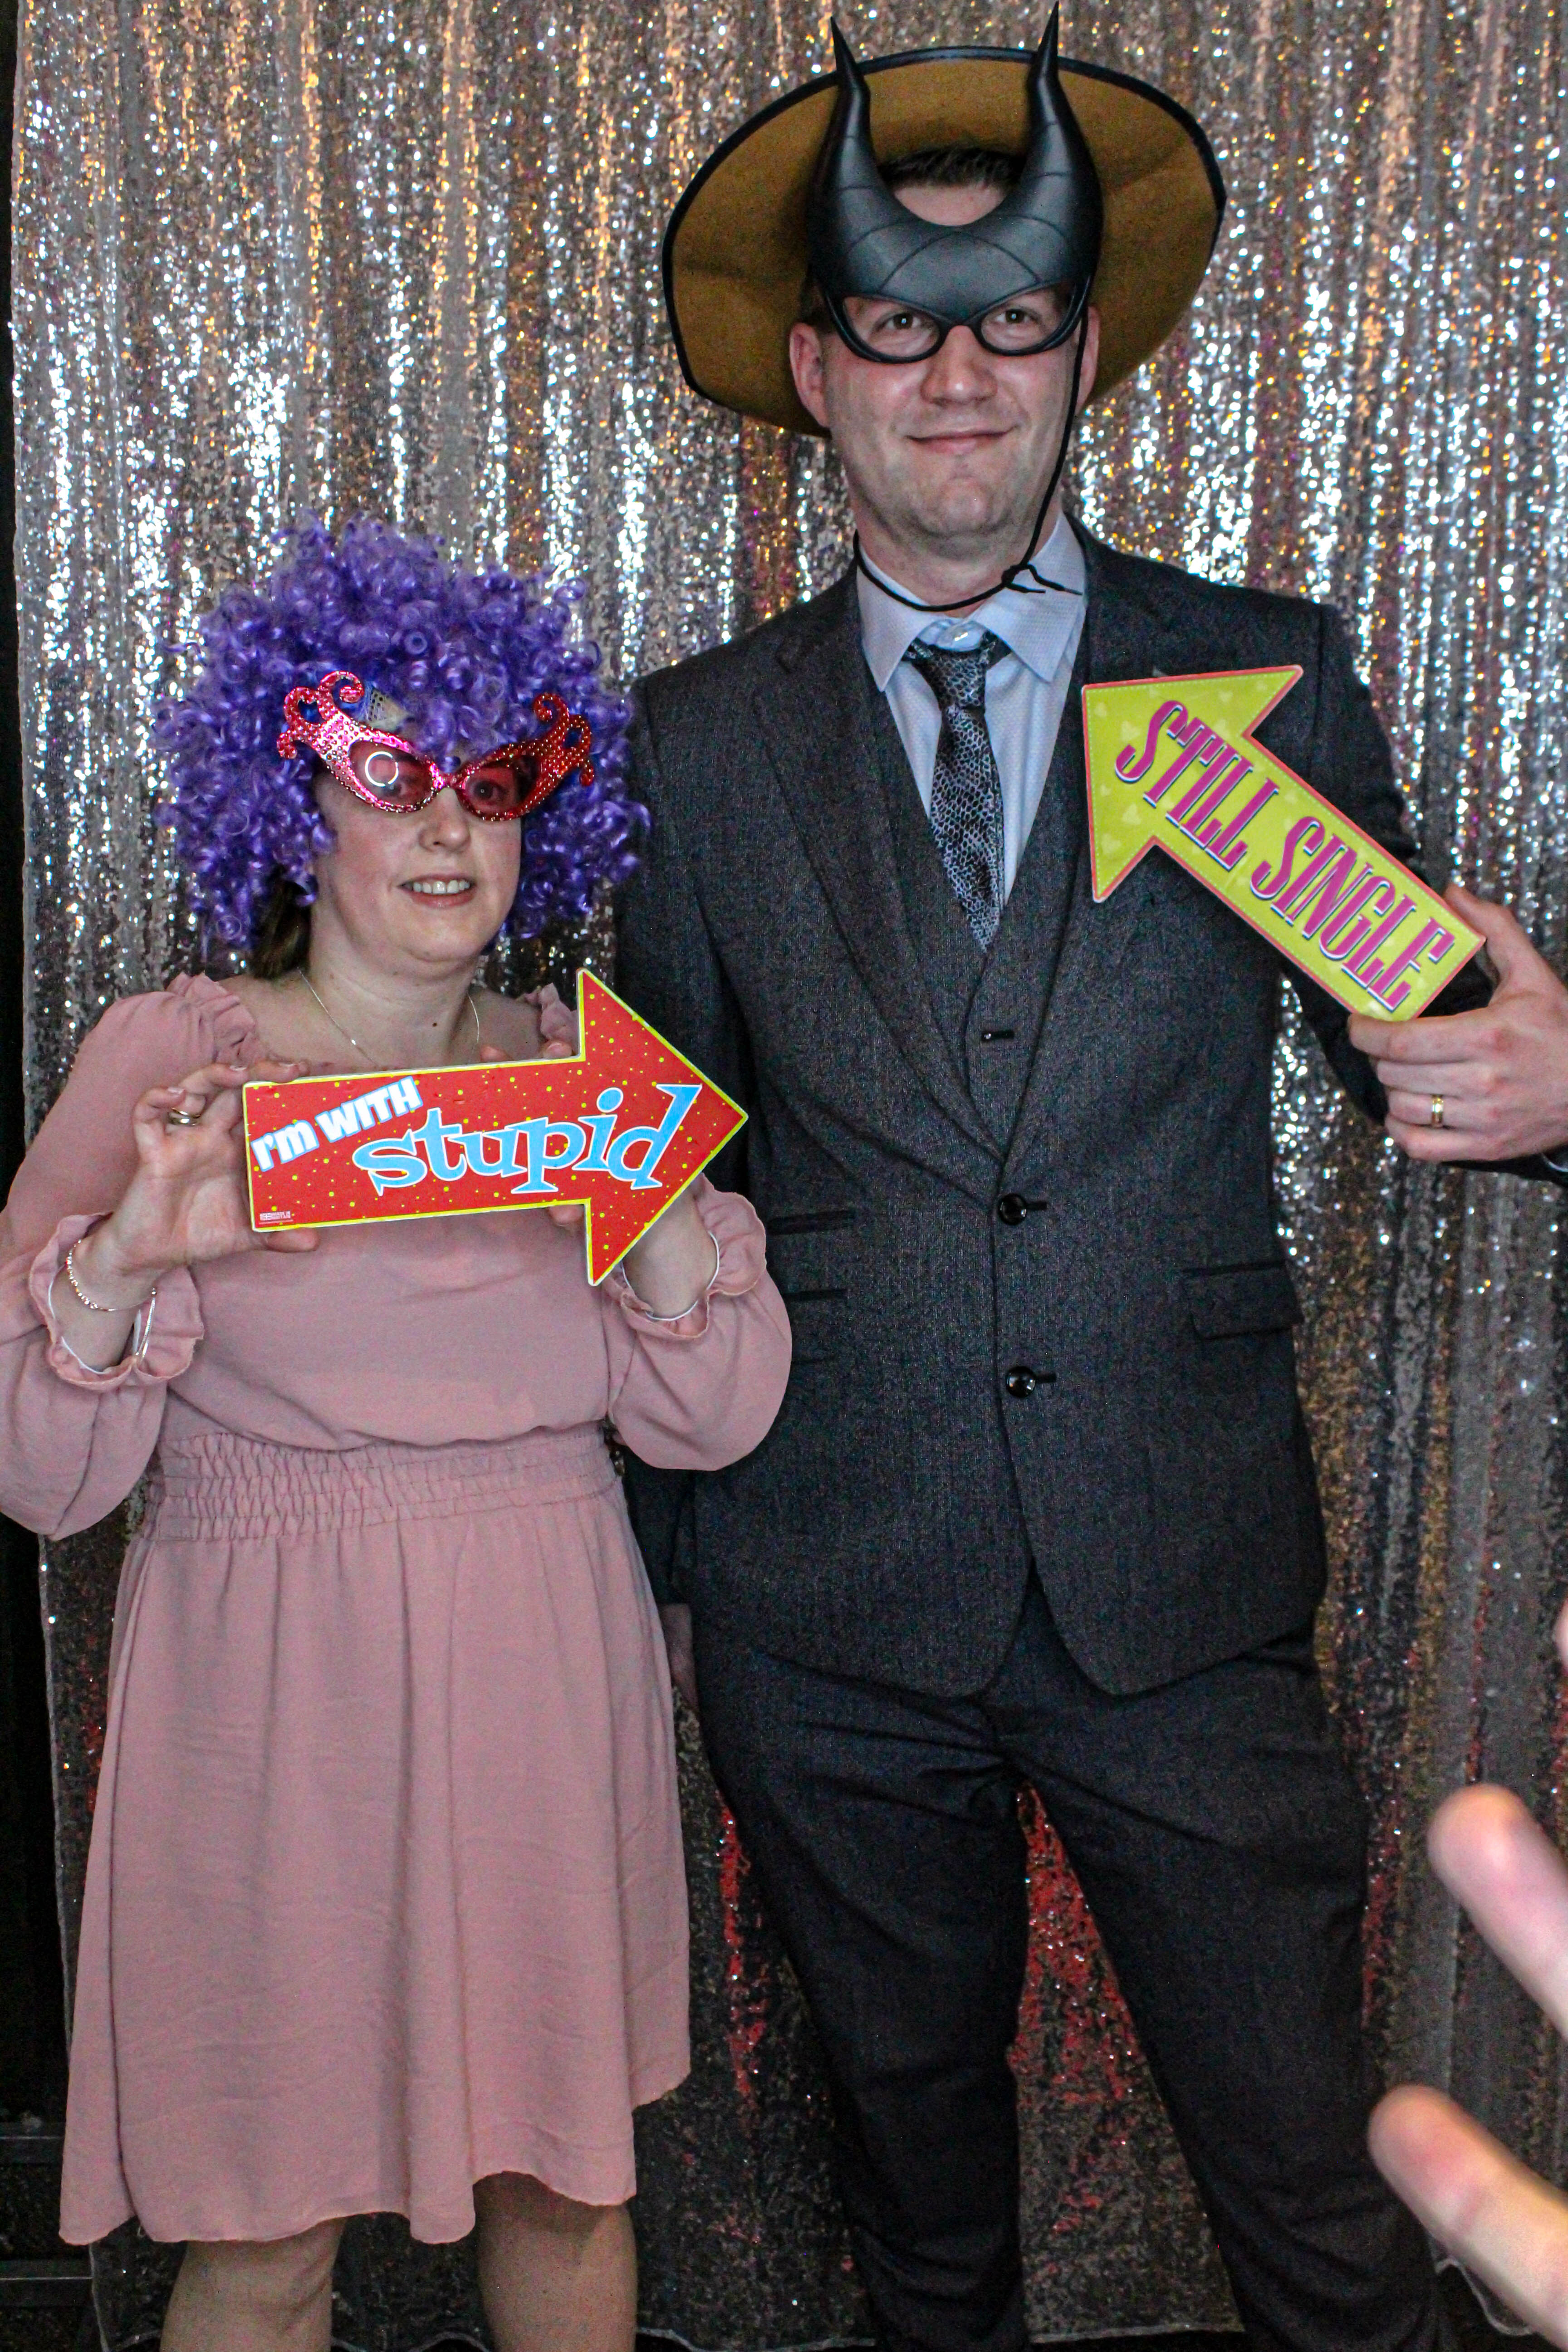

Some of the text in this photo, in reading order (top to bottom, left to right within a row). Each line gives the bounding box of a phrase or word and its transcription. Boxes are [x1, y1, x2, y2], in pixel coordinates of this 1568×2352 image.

[1115, 700, 1455, 1013] STILL SINGLE
[315, 1076, 423, 1143] WITH
[352, 1084, 702, 1196] stupid
